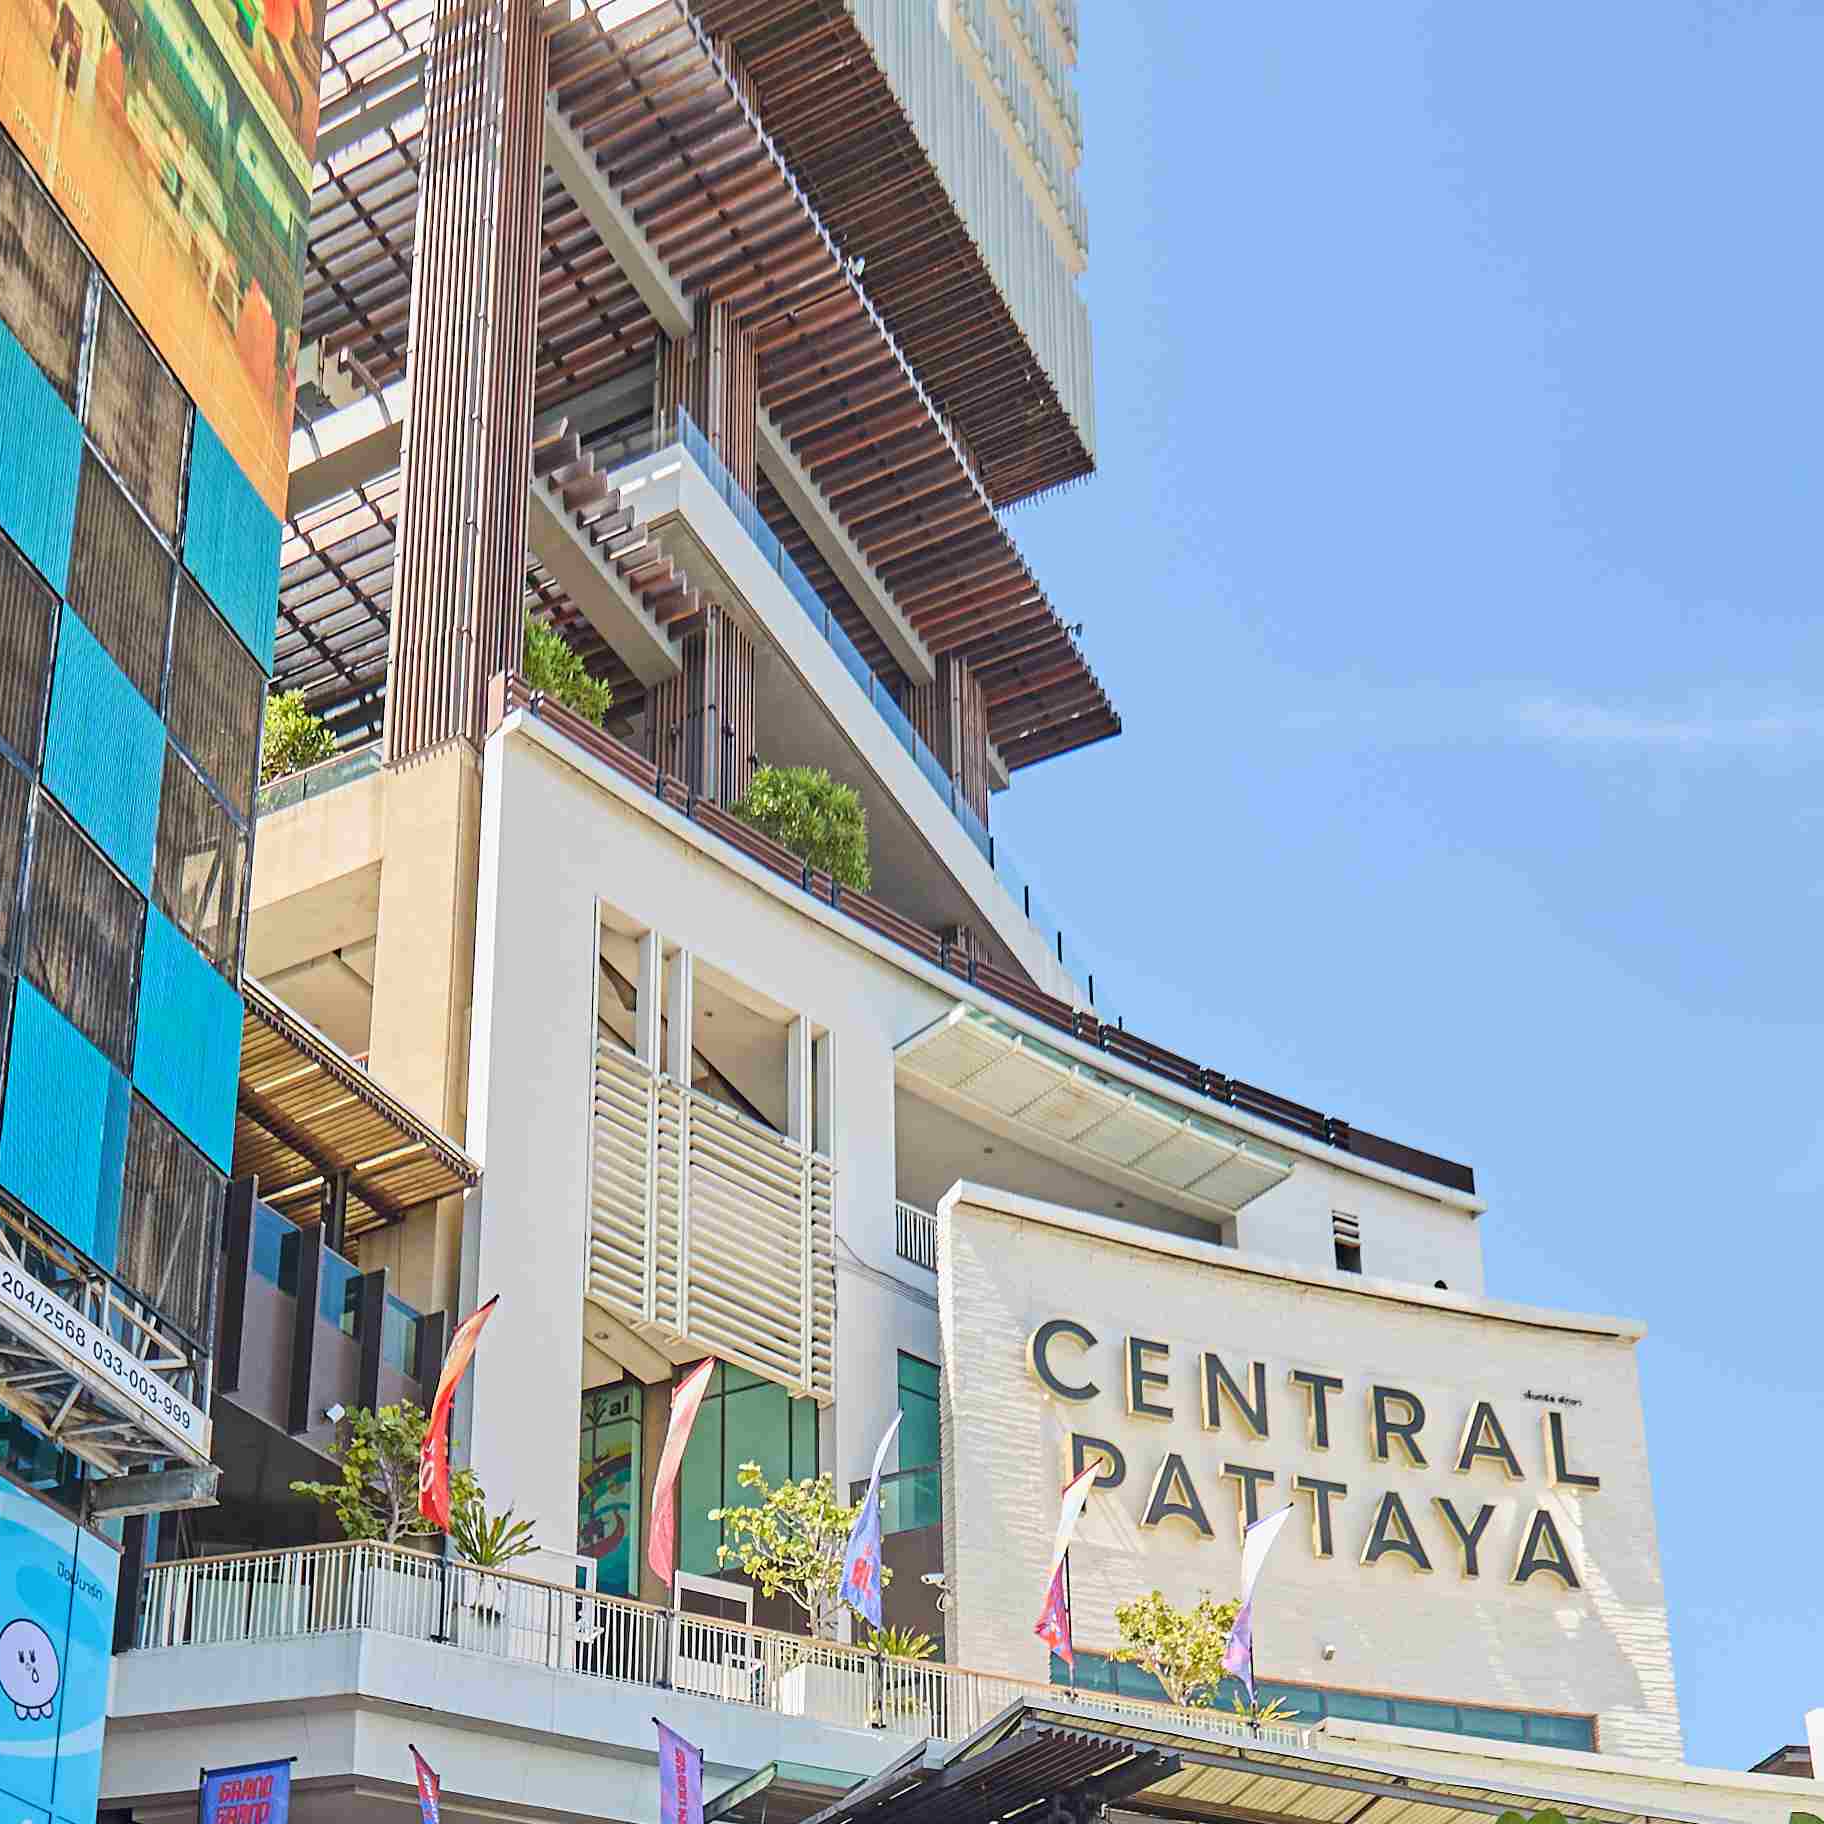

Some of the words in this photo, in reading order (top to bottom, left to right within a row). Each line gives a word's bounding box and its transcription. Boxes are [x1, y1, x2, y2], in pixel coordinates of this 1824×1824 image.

[1, 1271, 86, 1347] 204/2568
[93, 1340, 192, 1430] 033-003-999
[1026, 1318, 1601, 1492] CENTRAL
[1064, 1432, 1582, 1590] PATTAYA
